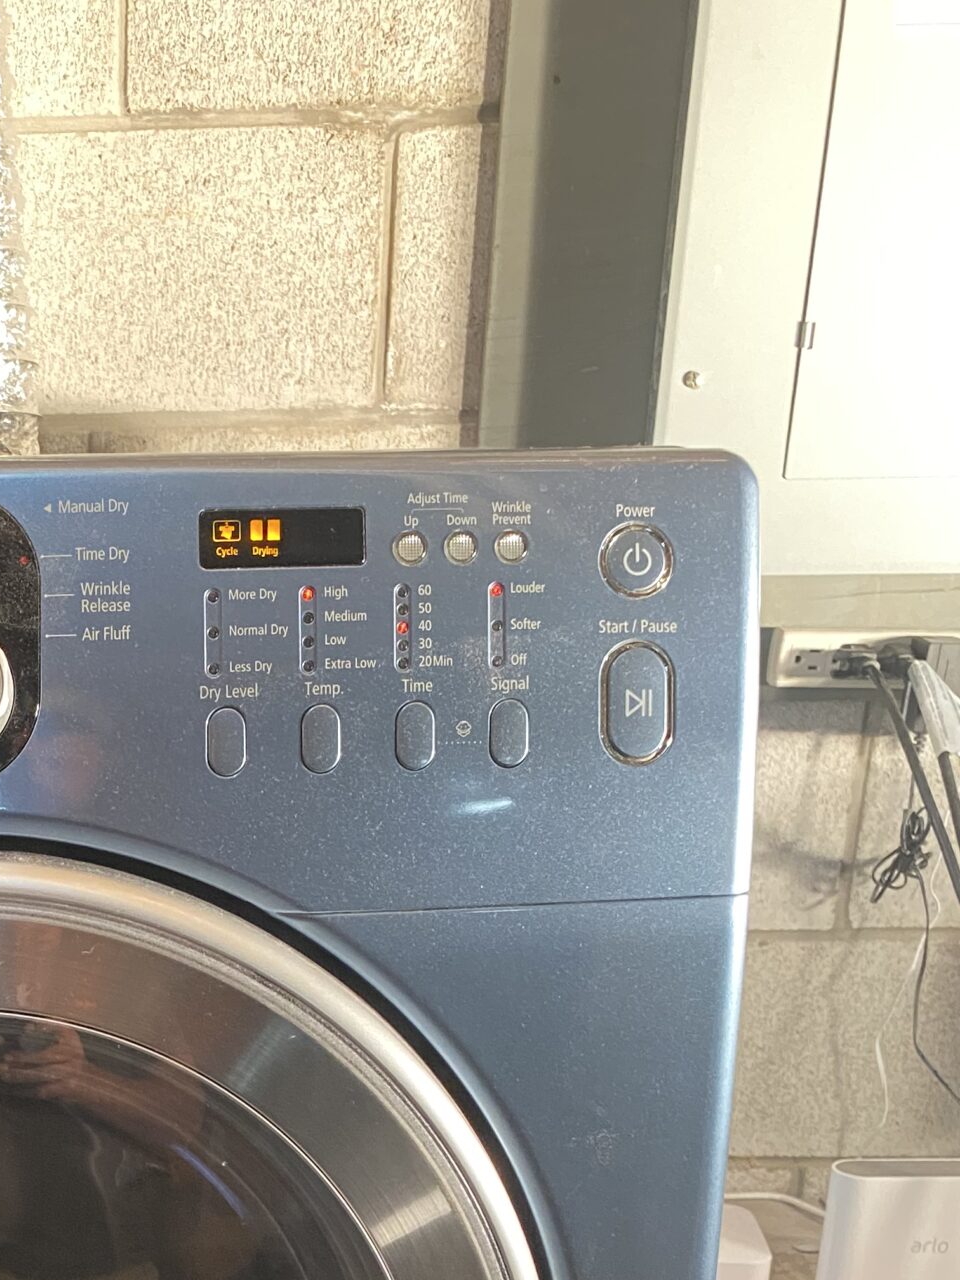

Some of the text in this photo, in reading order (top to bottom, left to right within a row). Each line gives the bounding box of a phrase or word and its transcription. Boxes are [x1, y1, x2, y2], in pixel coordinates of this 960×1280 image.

[407, 492, 468, 505] Adjust Time
[58, 499, 129, 516] Manual Dry
[491, 501, 532, 513] Wrinkle
[615, 504, 655, 518] Power
[403, 515, 419, 528] Up
[446, 514, 477, 526] Down
[492, 514, 532, 525] Prevent
[75, 546, 130, 563] Time Dry
[215, 546, 239, 557] Cycle
[252, 546, 279, 557] Drying
[80, 581, 131, 596] Wrinkle
[324, 587, 348, 598] High
[418, 585, 432, 596] 60
[510, 582, 545, 594] Louder
[228, 588, 277, 602] More Dry
[81, 599, 131, 613] Release
[418, 603, 432, 614] 50
[324, 611, 367, 622] Medium
[229, 624, 289, 638] Normal Dry
[418, 620, 432, 631] 40
[510, 619, 541, 630] Softer
[598, 619, 678, 634] Start / Pause
[82, 625, 131, 641] Air Fluff
[324, 635, 347, 646] Low
[418, 638, 432, 649] 30
[325, 658, 376, 669] Extra Low
[511, 654, 527, 666] Off
[229, 661, 273, 674] Less Dry
[305, 682, 344, 698] Temp.
[402, 679, 433, 693] Time
[490, 676, 530, 694] Signal
[199, 683, 259, 702] Dry Level
[910, 1238, 949, 1255] arlo
